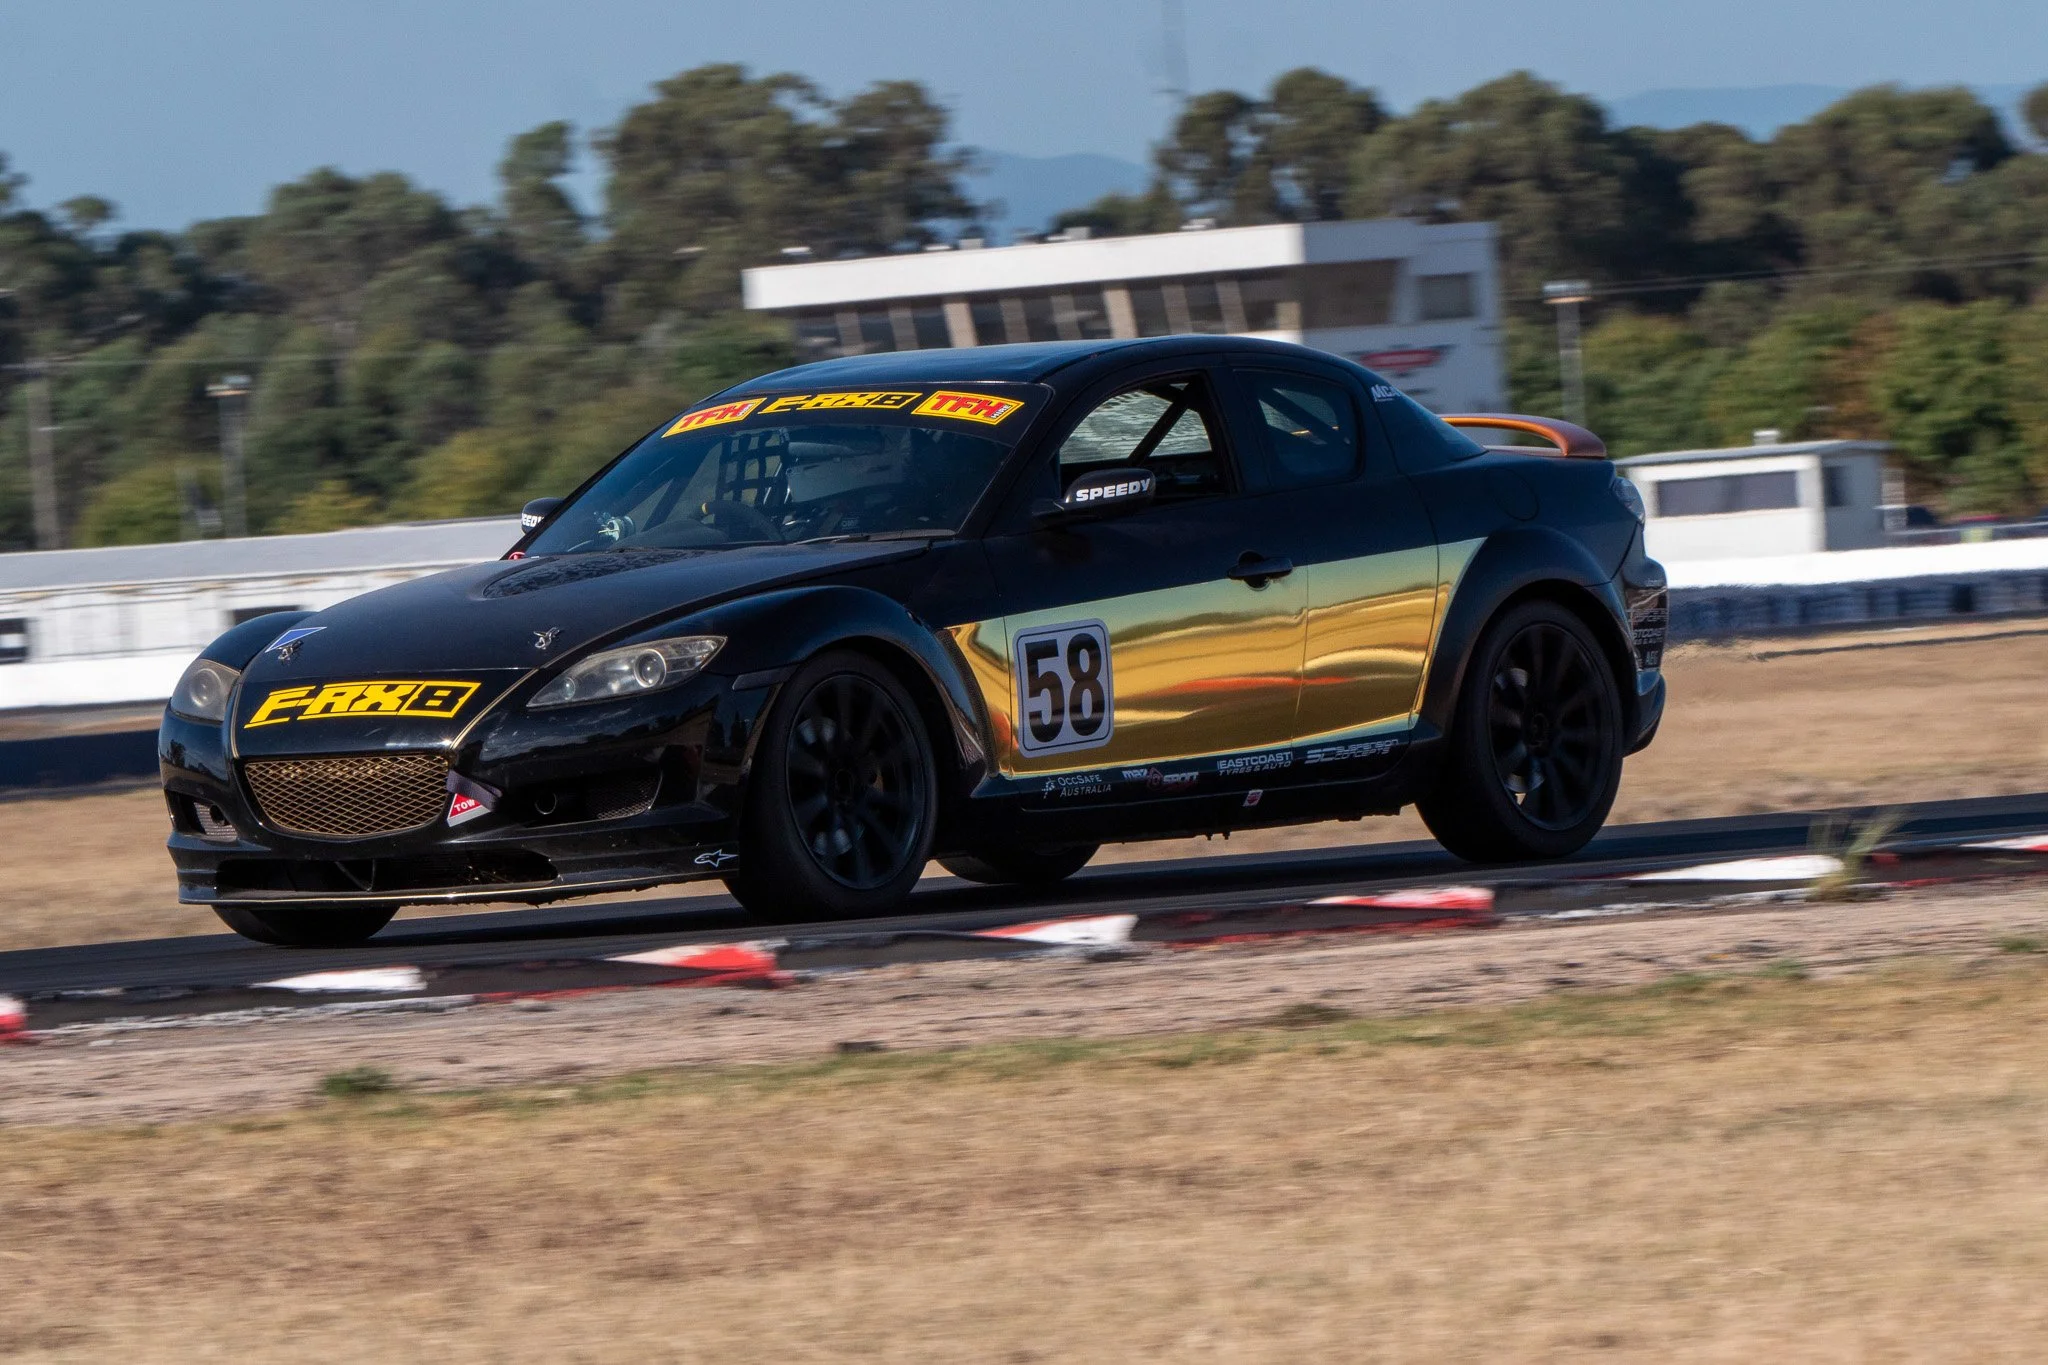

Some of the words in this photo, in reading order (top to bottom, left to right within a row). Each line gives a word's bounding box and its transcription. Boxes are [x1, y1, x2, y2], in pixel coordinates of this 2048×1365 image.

[680, 403, 748, 429] TFH
[931, 394, 1005, 419] TFH
[1076, 478, 1150, 502] SPEEDY
[521, 513, 545, 528] EEDY
[1025, 633, 1105, 743] 58
[1218, 751, 1292, 770] EASTCOAST
[1218, 766, 1253, 776] TYRES
[1262, 761, 1292, 770] AUTO
[1060, 784, 1112, 798] AUSTRALIA
[453, 799, 476, 812] TOW
